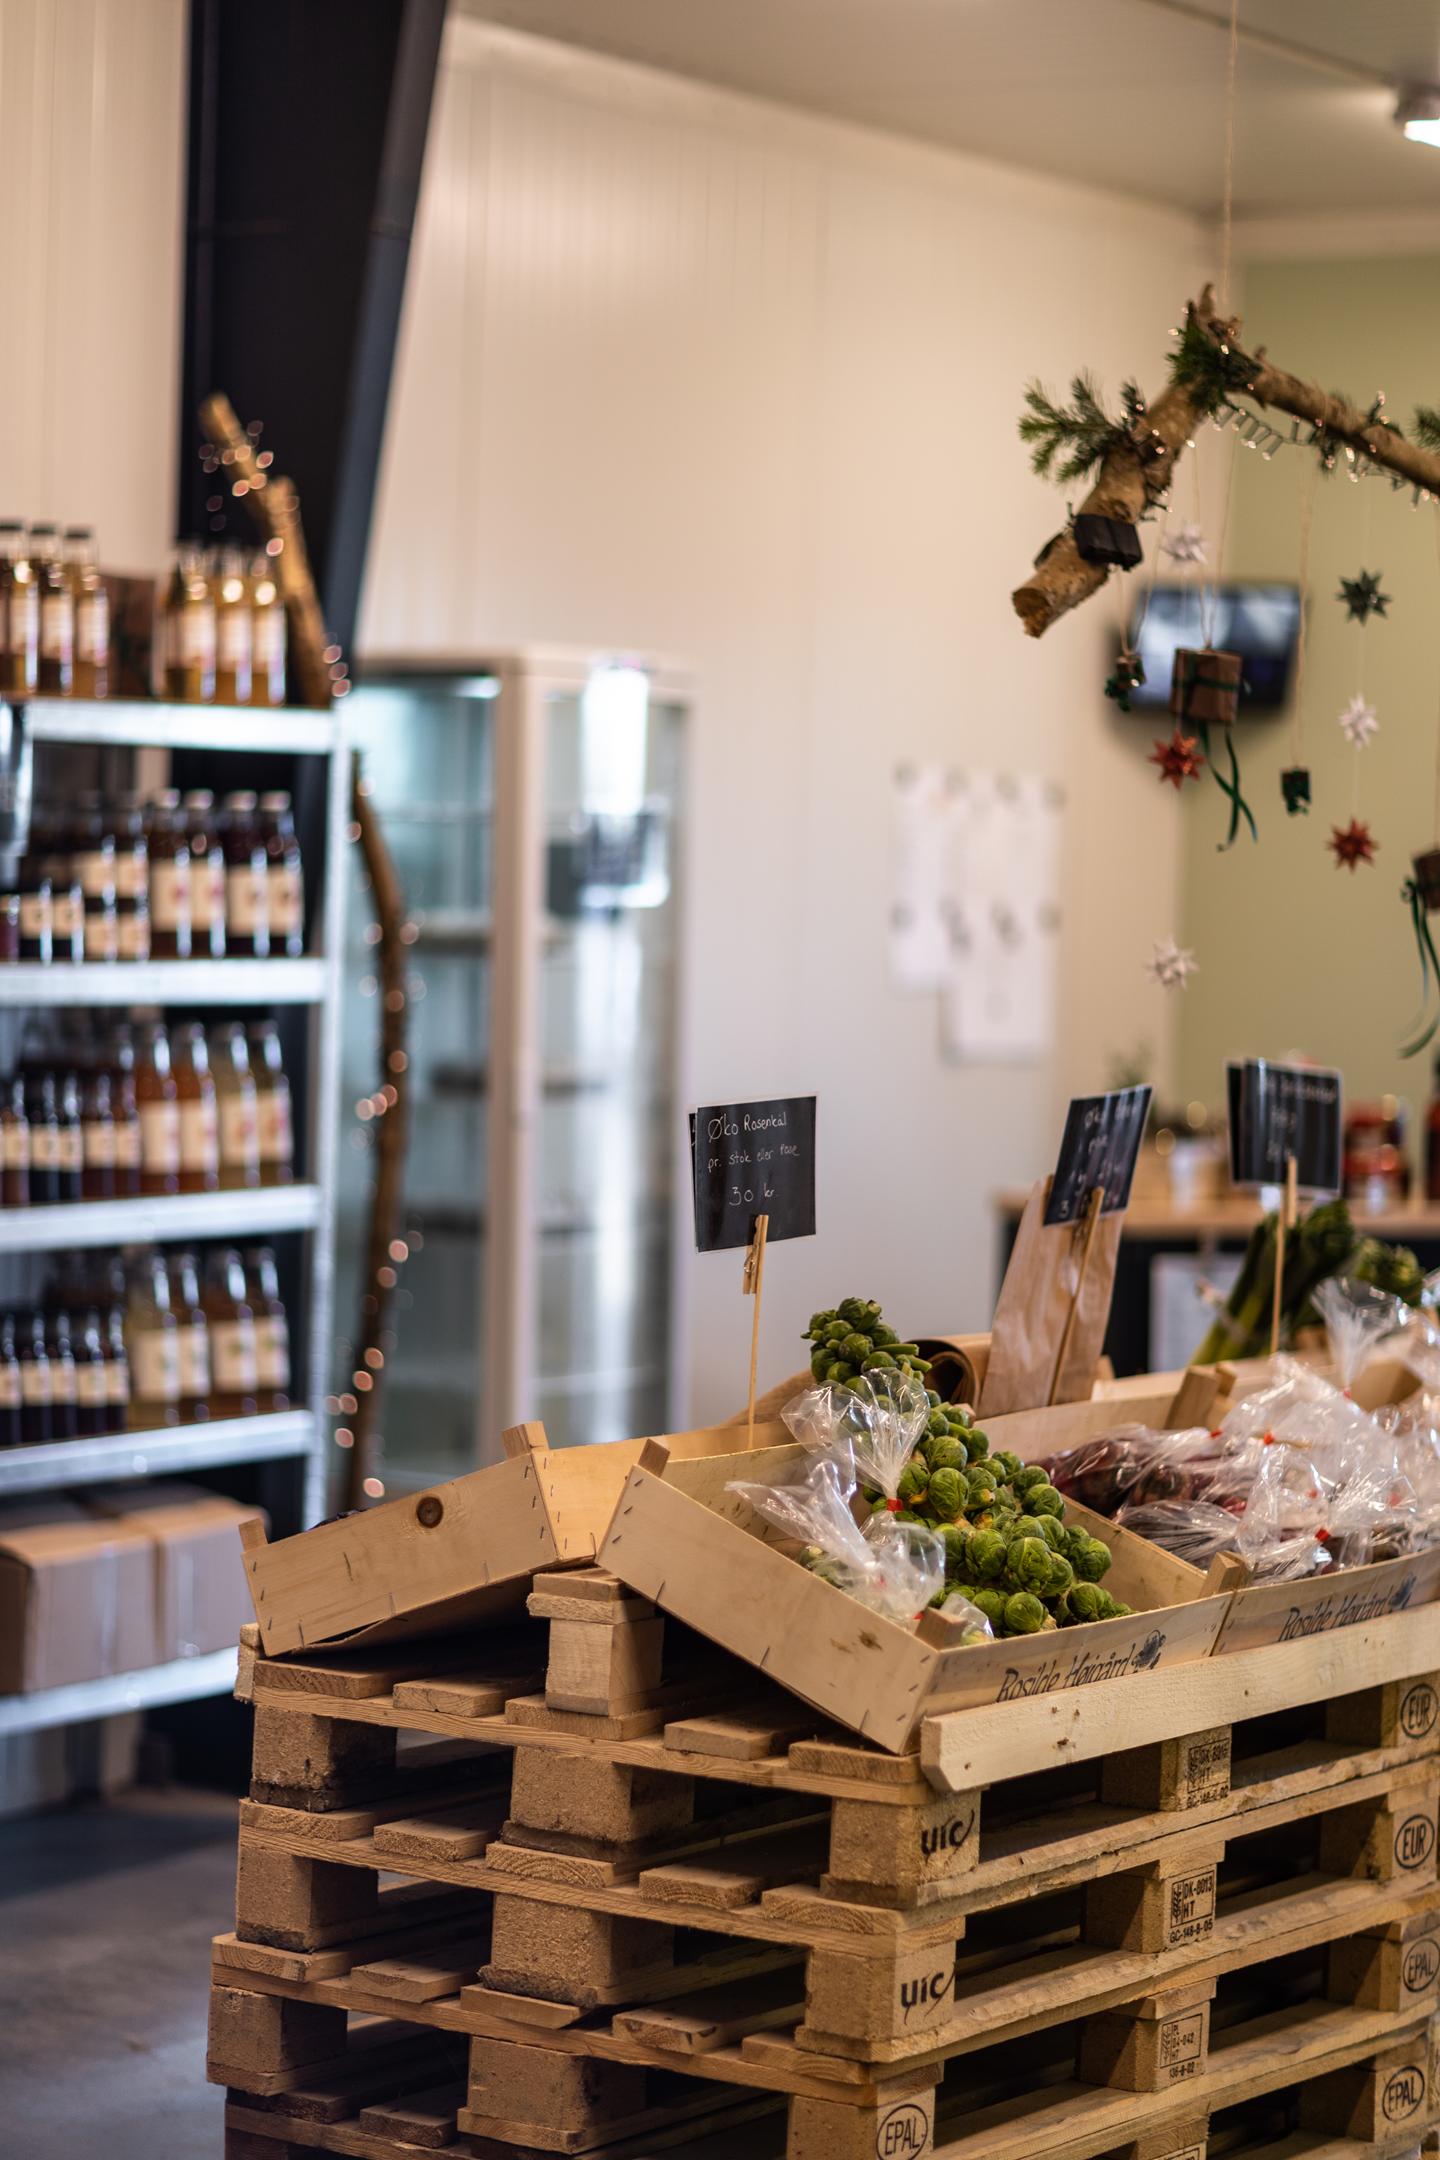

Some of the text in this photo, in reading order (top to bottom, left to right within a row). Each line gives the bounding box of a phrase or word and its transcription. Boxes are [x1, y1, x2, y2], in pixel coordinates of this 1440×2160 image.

[707, 1111, 787, 1143] Øko Rosenkål
[707, 1157, 722, 1173] pr.
[728, 1186, 754, 1206] 30
[997, 1659, 1060, 1703] Rosilde
[1408, 1693, 1431, 1730] EUR
[1402, 1823, 1427, 1861] EUR
[1183, 1900, 1196, 1918] HT
[1407, 1952, 1434, 1985] EPAL
[1388, 2075, 1419, 2113] EPAL
[884, 2115, 921, 2156] EPAL
